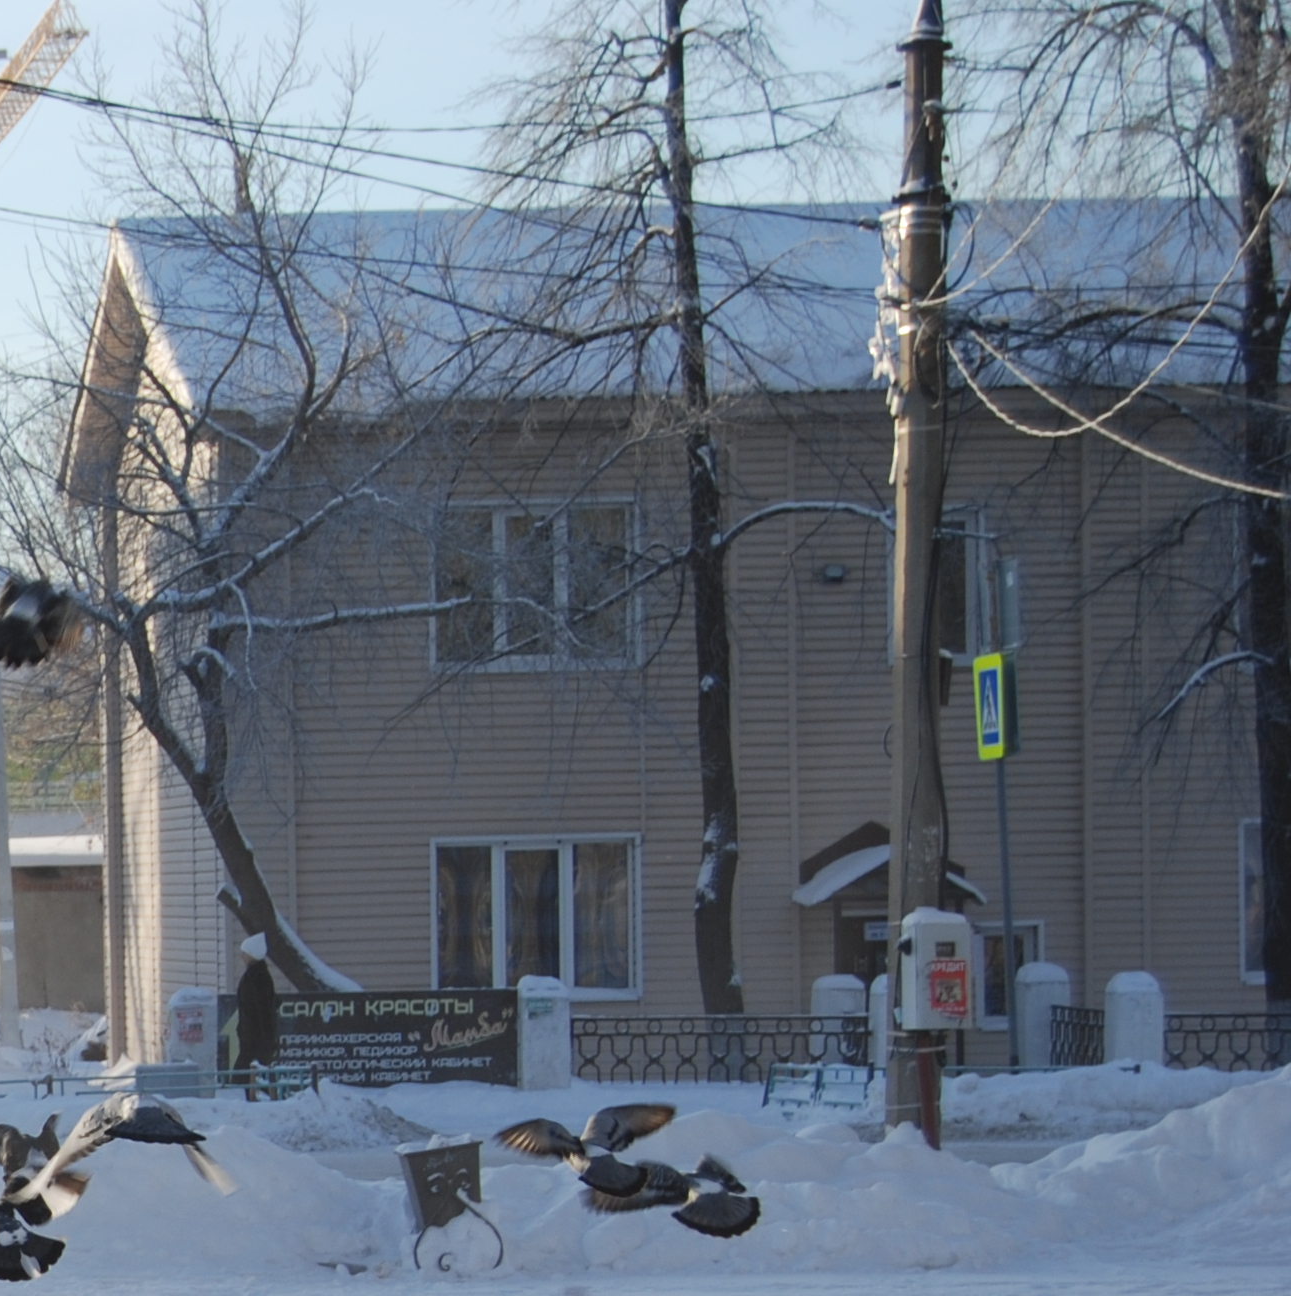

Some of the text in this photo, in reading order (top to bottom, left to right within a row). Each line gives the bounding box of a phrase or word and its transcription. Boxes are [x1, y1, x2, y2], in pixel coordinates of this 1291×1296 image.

[279, 999, 474, 1018] САЛОН КРАСОТЫ
[279, 1032, 402, 1045] ПАРИКМАХЕРСКАЯ
[280, 1045, 418, 1058] МАНИКЮР, ПЕДИКЮР
[432, 1056, 493, 1067] КАБИНЕТ
[371, 1070, 432, 1082] КАБИНЕТ
